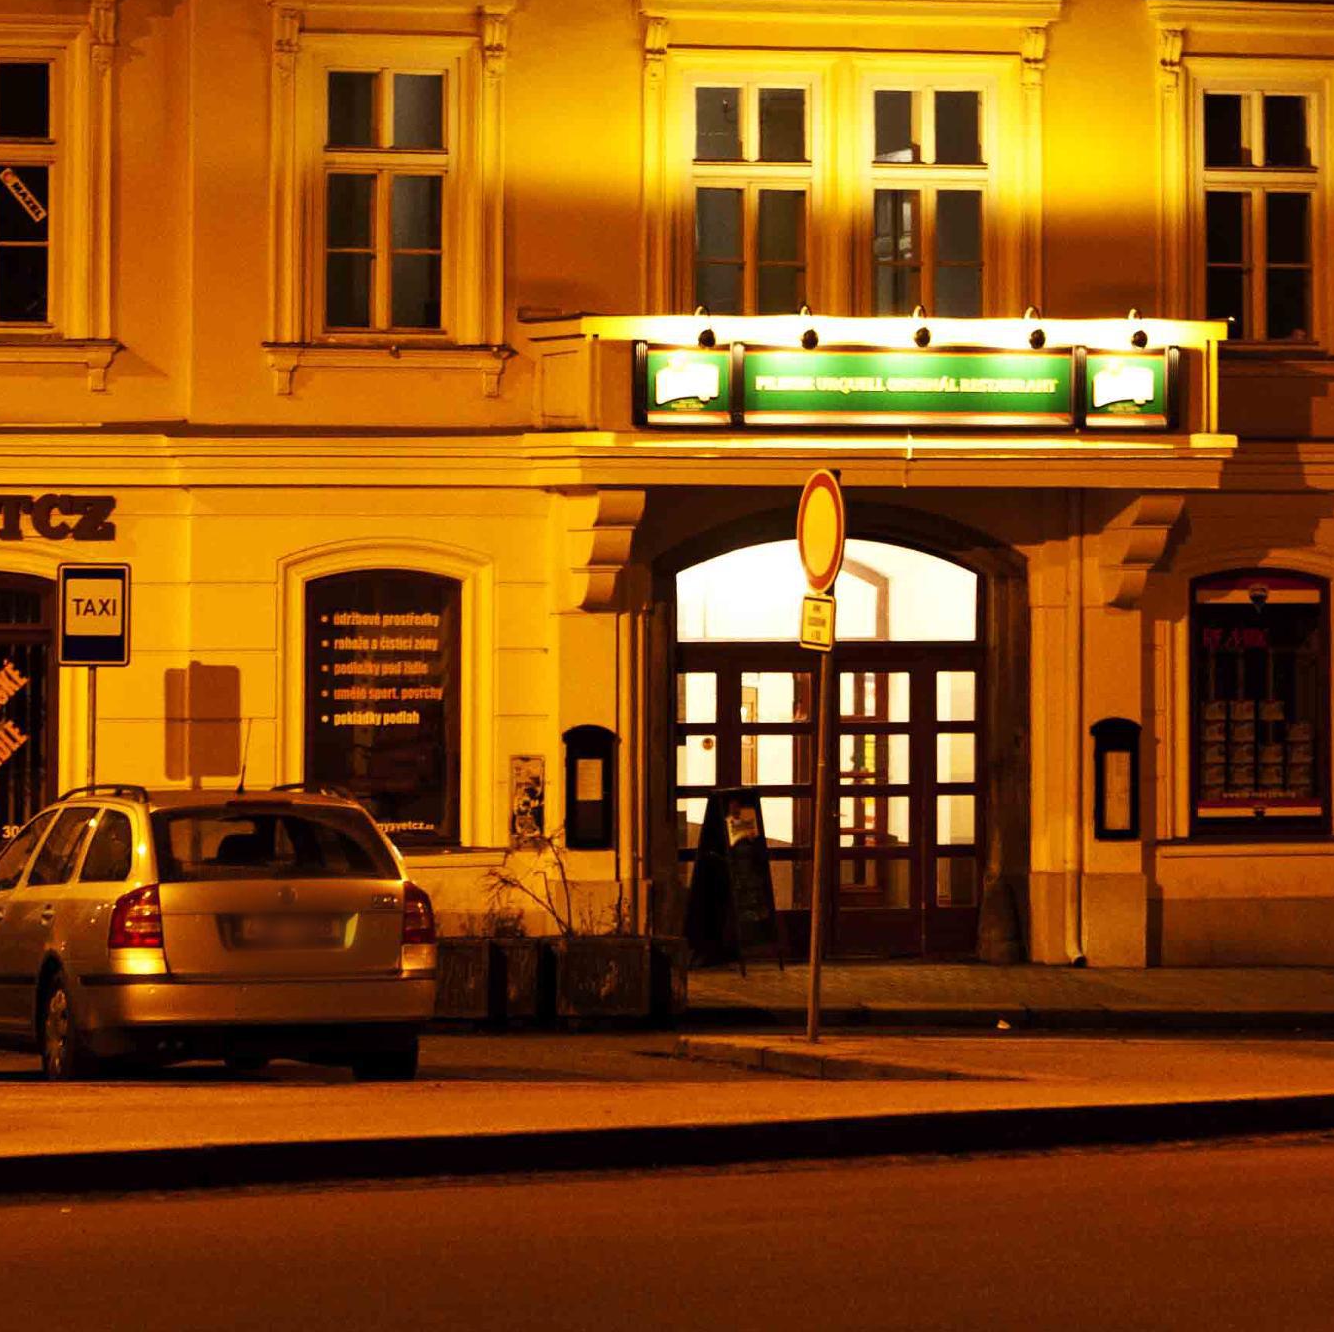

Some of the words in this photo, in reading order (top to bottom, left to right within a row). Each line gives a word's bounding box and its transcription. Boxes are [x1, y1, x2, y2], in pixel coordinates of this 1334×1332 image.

[72, 598, 117, 617] TAXI
[382, 612, 439, 628] prostředky
[334, 711, 381, 726] pokládky
[383, 711, 419, 725] podlah
